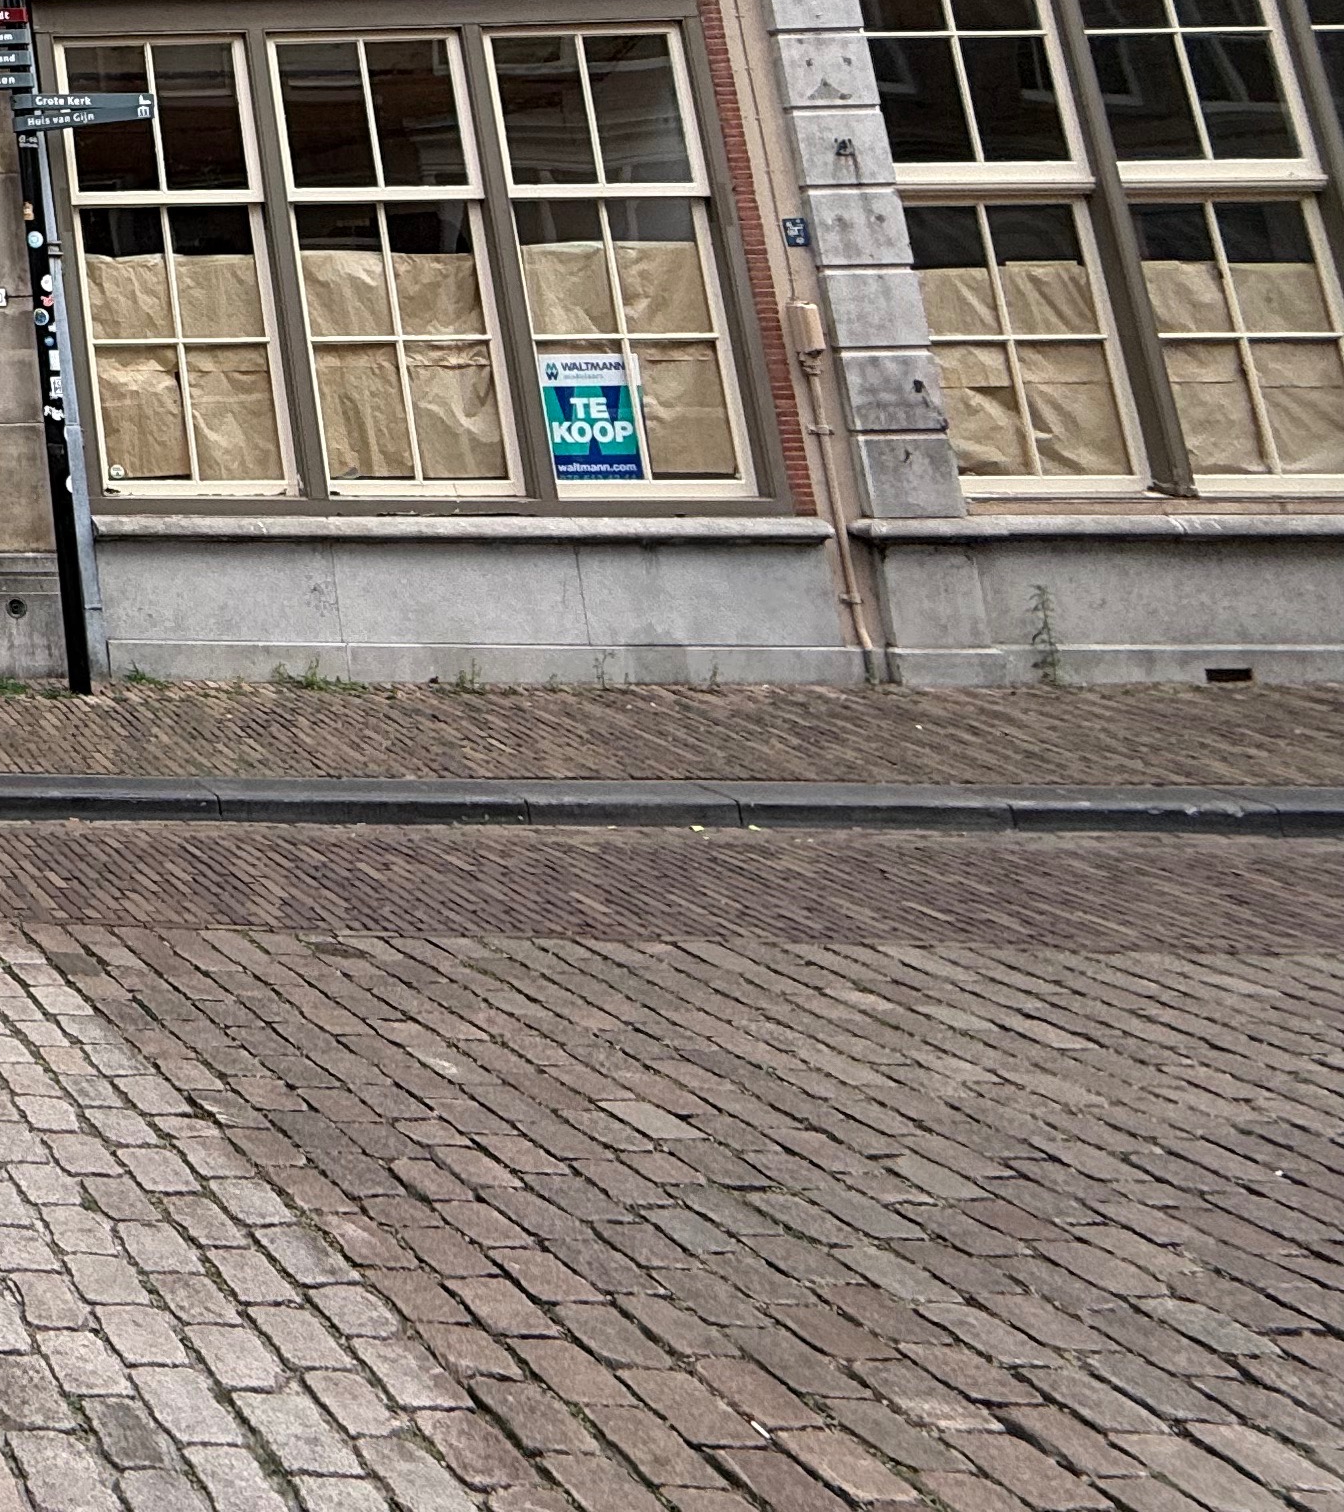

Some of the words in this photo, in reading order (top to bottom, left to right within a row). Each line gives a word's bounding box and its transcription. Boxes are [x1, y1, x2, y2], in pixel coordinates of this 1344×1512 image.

[35, 96, 65, 106] Grote
[67, 96, 92, 105] Kerk
[27, 116, 50, 126] Huis
[53, 115, 71, 124] van
[73, 111, 95, 123] Gijn
[561, 361, 626, 372] WALTMANN
[570, 397, 610, 419] TE
[552, 421, 633, 443] KOOP
[558, 463, 637, 472] waltmann.com
